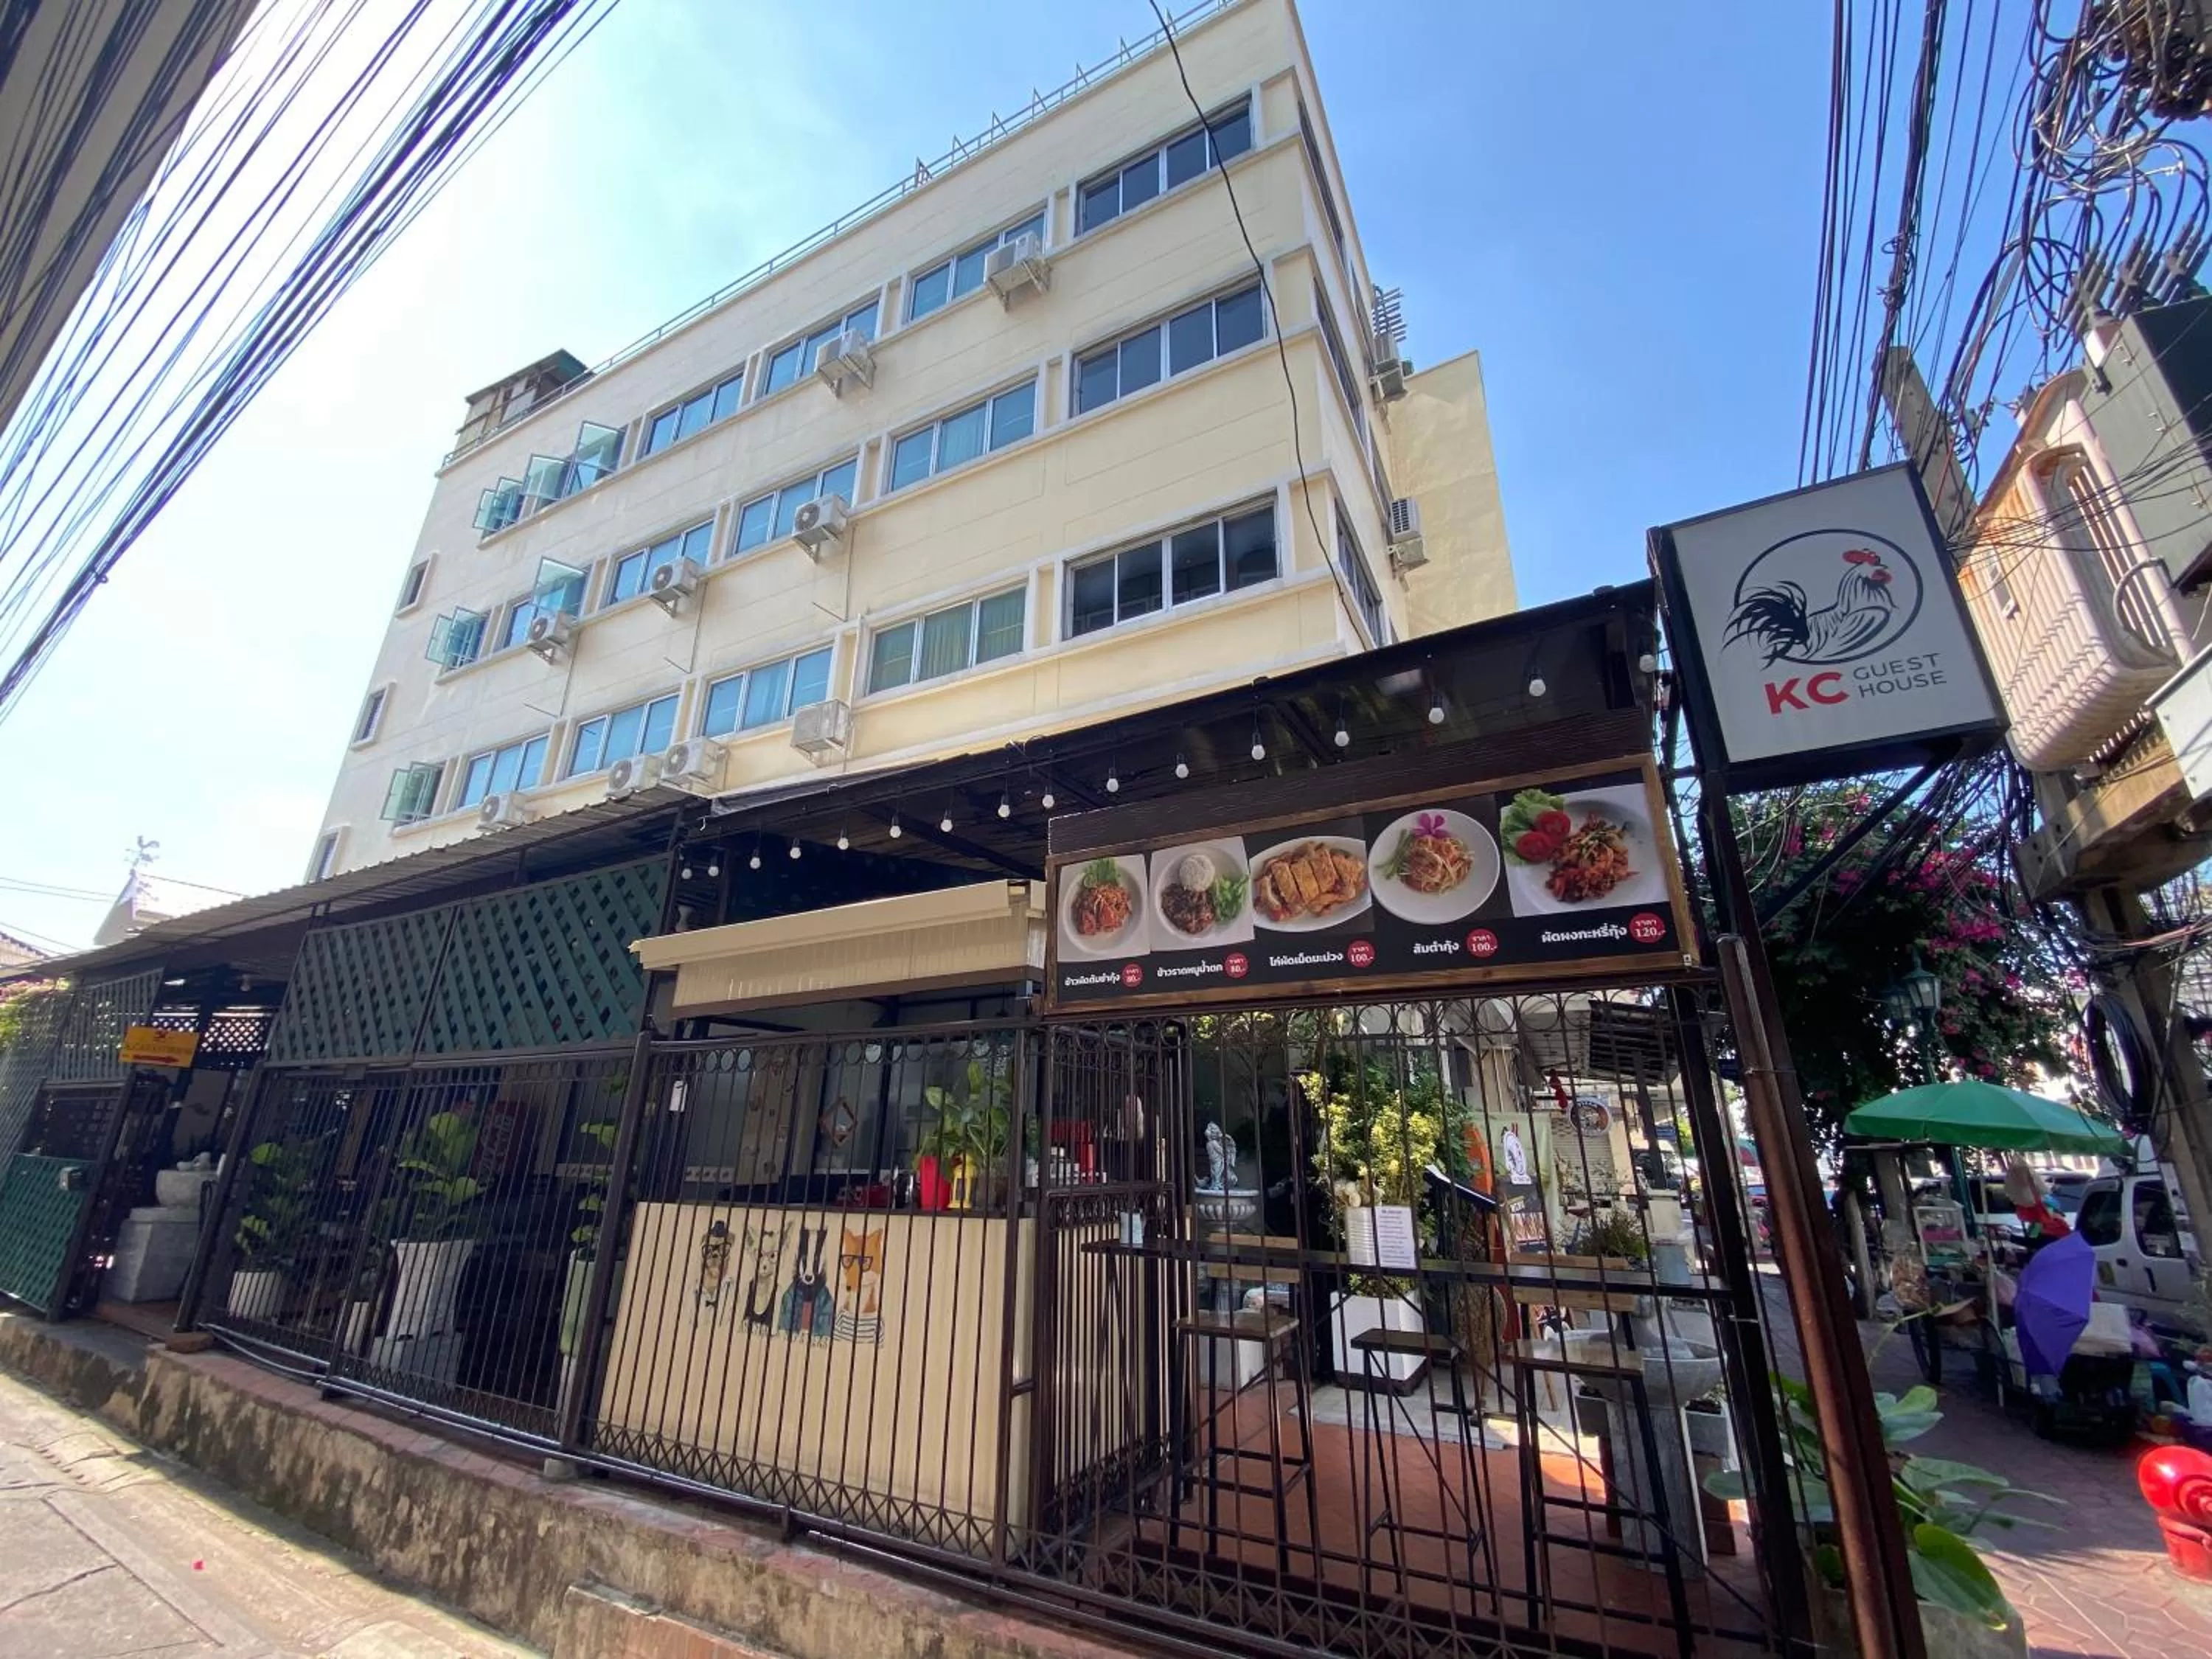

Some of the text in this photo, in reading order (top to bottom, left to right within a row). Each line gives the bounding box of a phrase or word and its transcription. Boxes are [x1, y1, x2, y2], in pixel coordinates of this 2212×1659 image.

[1853, 653, 1941, 681] GUEST
[1764, 672, 1849, 714] KC
[1859, 671, 1947, 698] HOUSE
